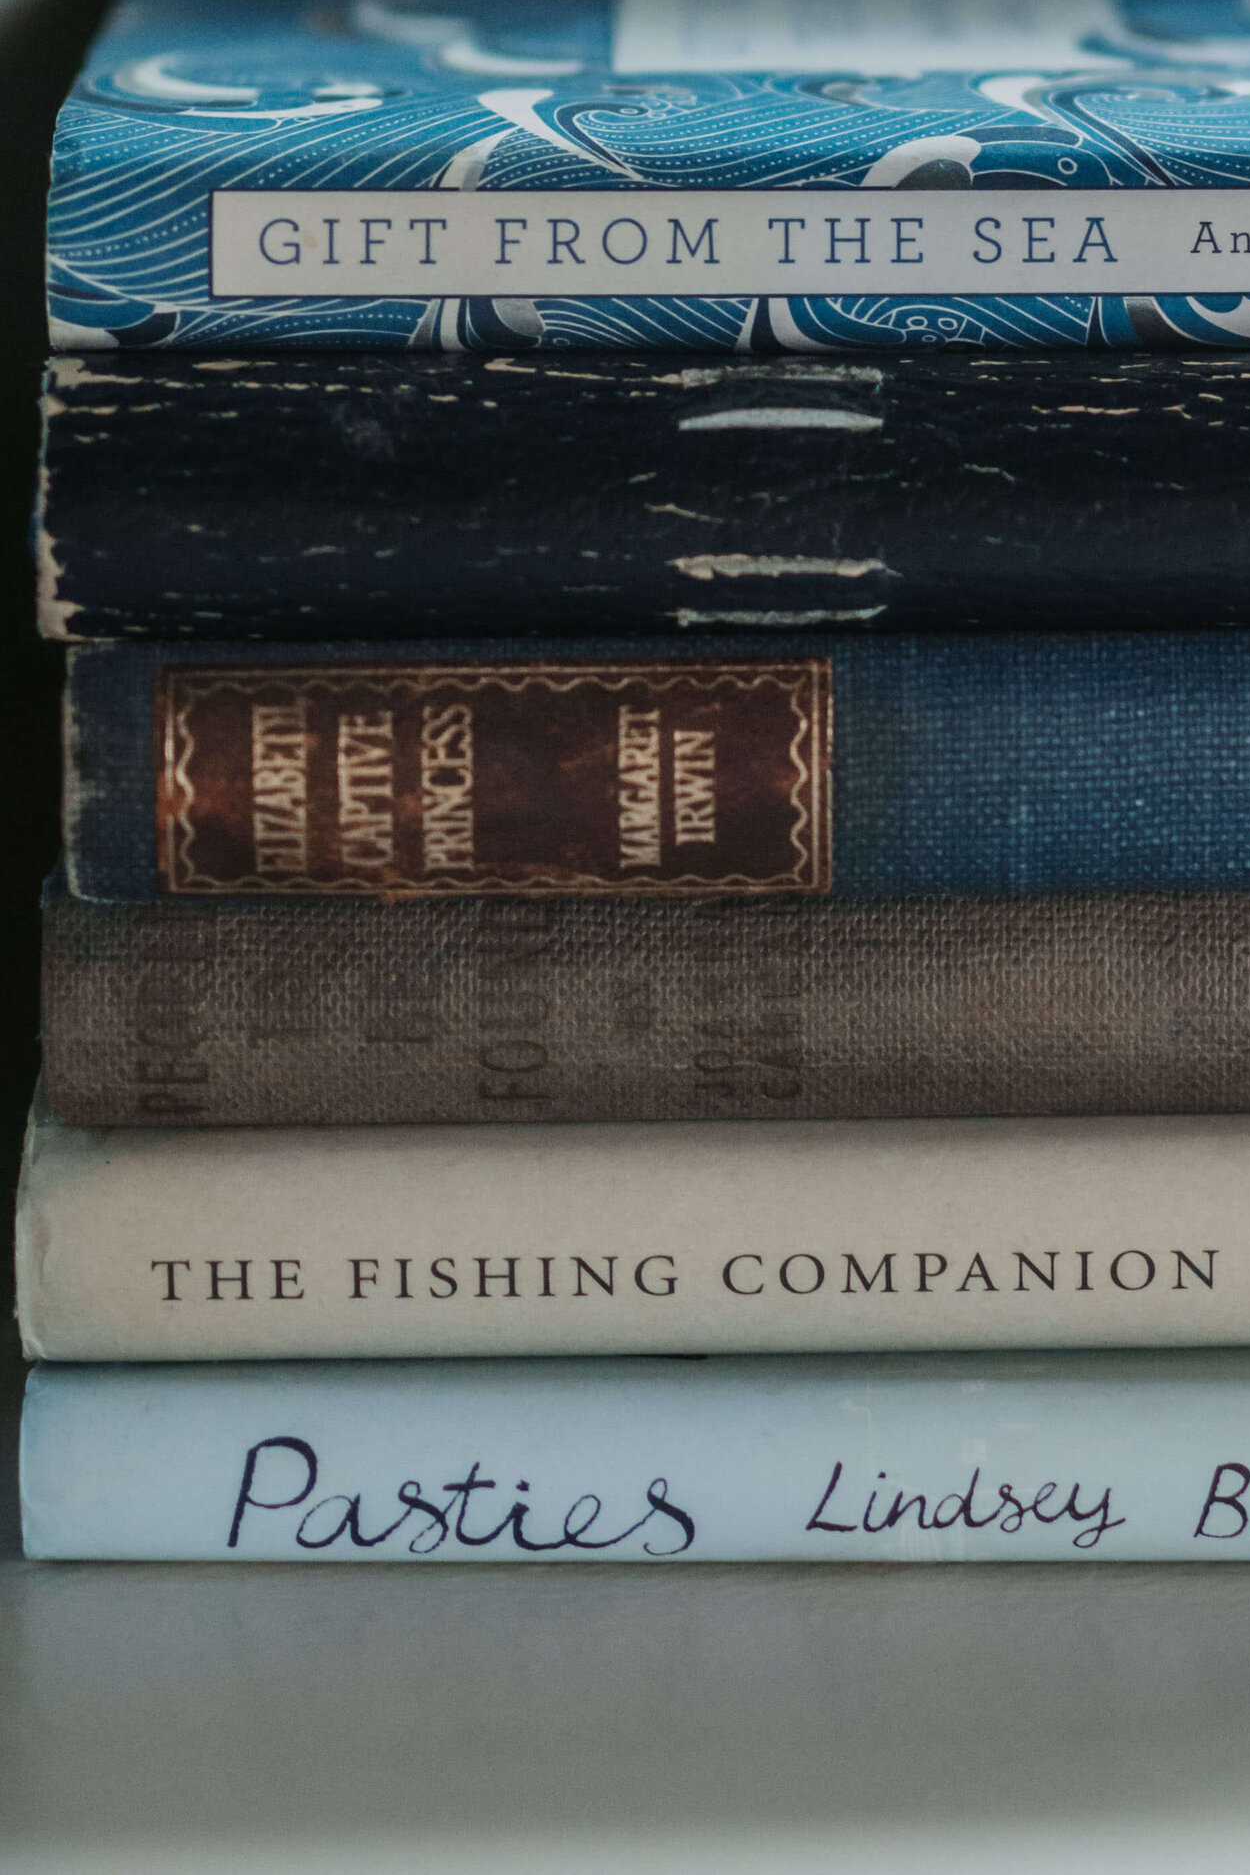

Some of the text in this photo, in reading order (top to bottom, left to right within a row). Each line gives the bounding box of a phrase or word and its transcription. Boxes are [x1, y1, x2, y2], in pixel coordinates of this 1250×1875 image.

[259, 216, 1119, 266] GIFT FROM THE SEA
[337, 710, 393, 868] CAPTIVE
[420, 704, 474, 872] PRINCESS
[618, 706, 662, 869] MARGARET
[673, 729, 716, 845] IRWIN
[151, 1248, 1220, 1302] THE FISHING COMPANION
[226, 1436, 697, 1556] Pasties
[804, 1461, 1127, 1550] Lindsey
